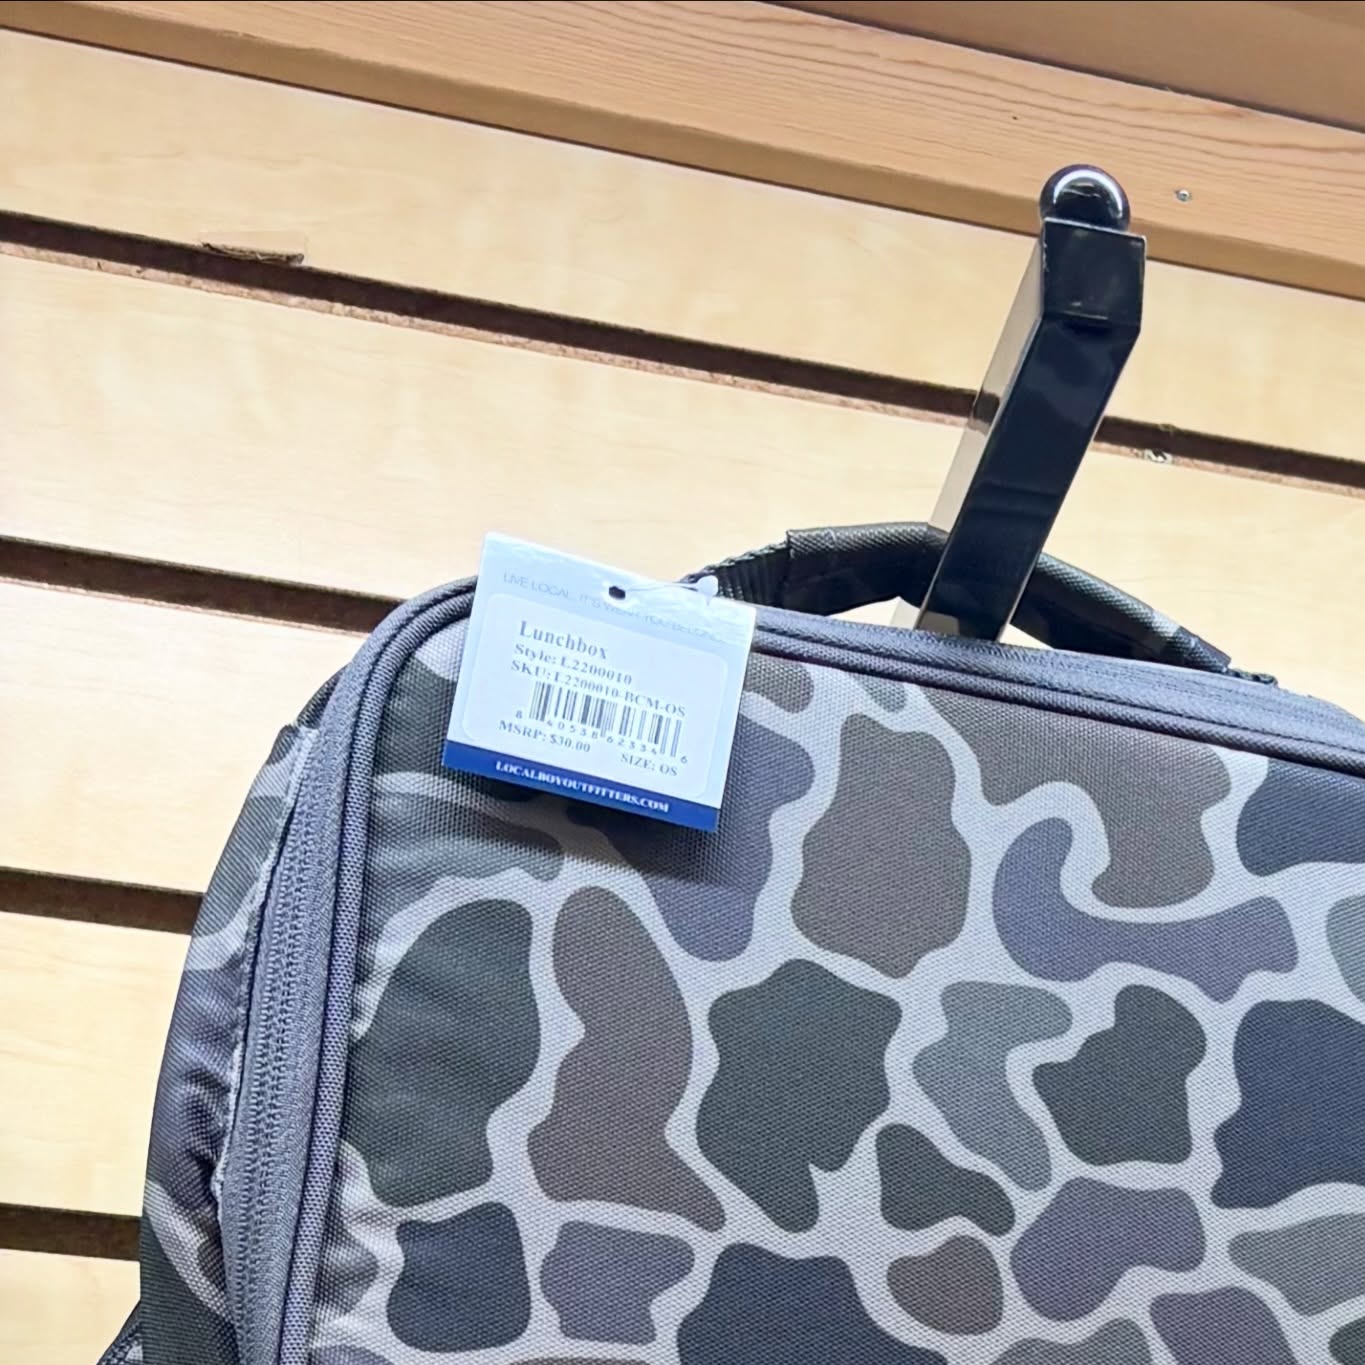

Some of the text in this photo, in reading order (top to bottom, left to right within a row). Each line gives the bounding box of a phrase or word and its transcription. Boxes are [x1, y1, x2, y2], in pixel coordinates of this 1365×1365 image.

[519, 620, 609, 660] Lunchbox
[511, 659, 551, 681] SKU:
[514, 643, 633, 686] Style: L2200010
[498, 720, 592, 753] MSRP: $30.00
[620, 753, 679, 777] SIZE: OS
[495, 760, 670, 813] LOCALBOYOUTFITTERS.COM
